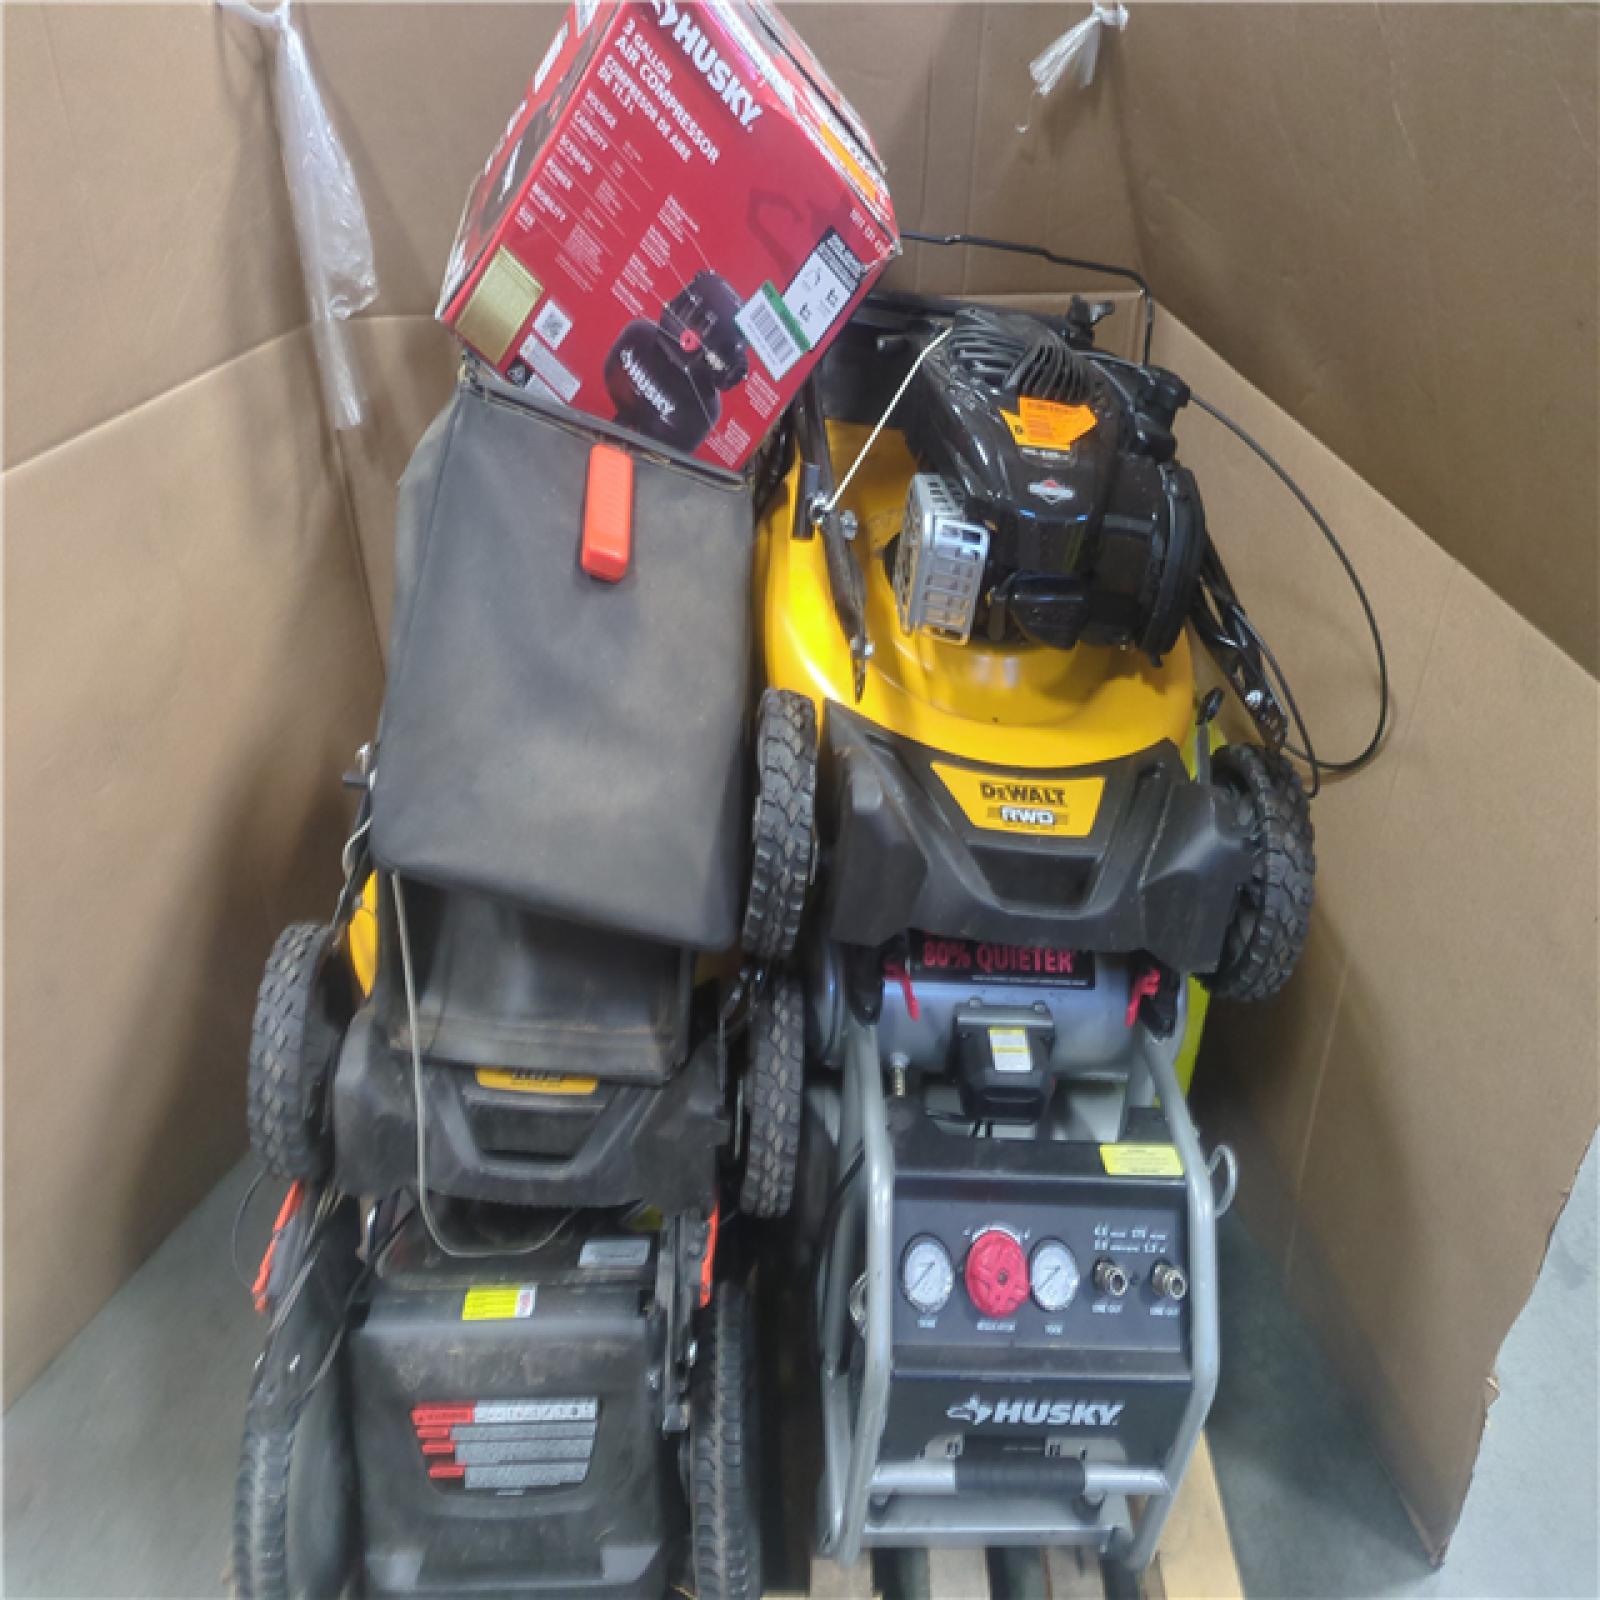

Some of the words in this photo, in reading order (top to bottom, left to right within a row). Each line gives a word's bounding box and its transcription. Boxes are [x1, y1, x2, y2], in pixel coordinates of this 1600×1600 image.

[614, 36, 641, 68] AIR
[639, 63, 720, 165] COMPRESSOR
[672, 12, 763, 126] HUSKY
[975, 943, 1074, 973] QUIETER
[991, 1400, 1124, 1426] HUSKY
